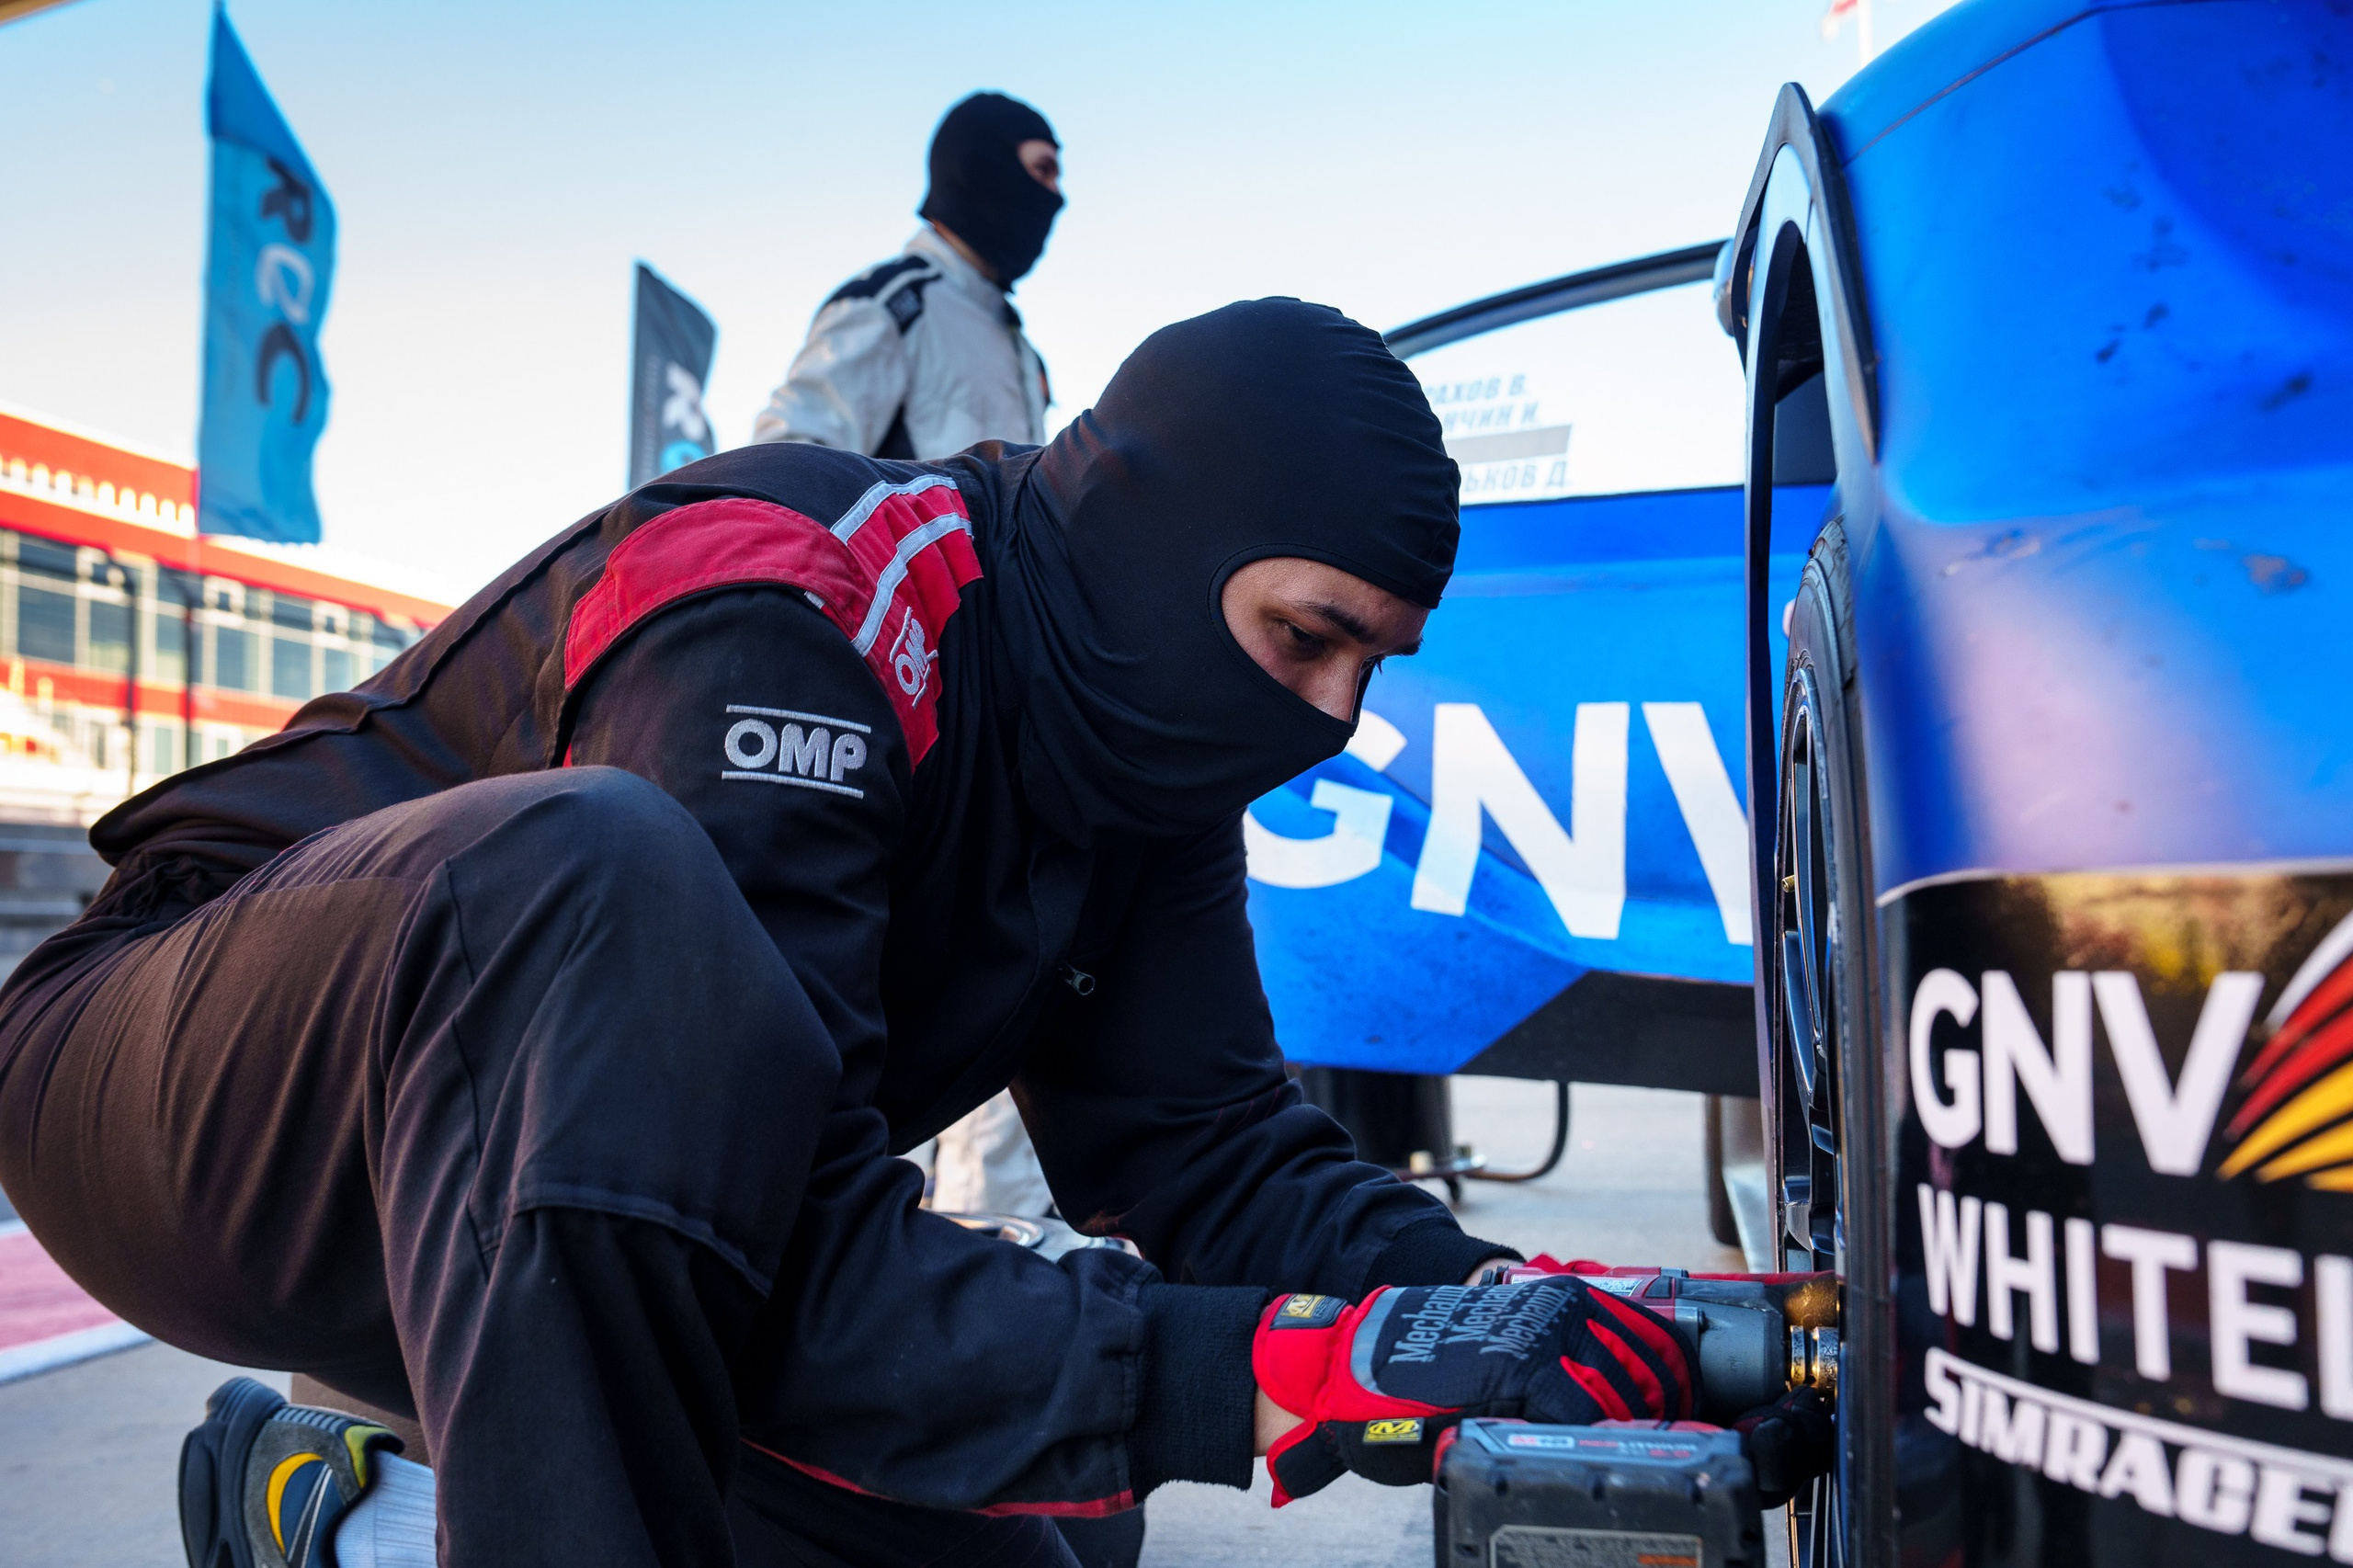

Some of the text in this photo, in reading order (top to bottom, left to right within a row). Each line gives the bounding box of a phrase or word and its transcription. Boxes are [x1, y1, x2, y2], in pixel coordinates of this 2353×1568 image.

[724, 718, 868, 782] OMP
[1909, 967, 2265, 1177] GNV
[1479, 1285, 1572, 1359] Mechanix
